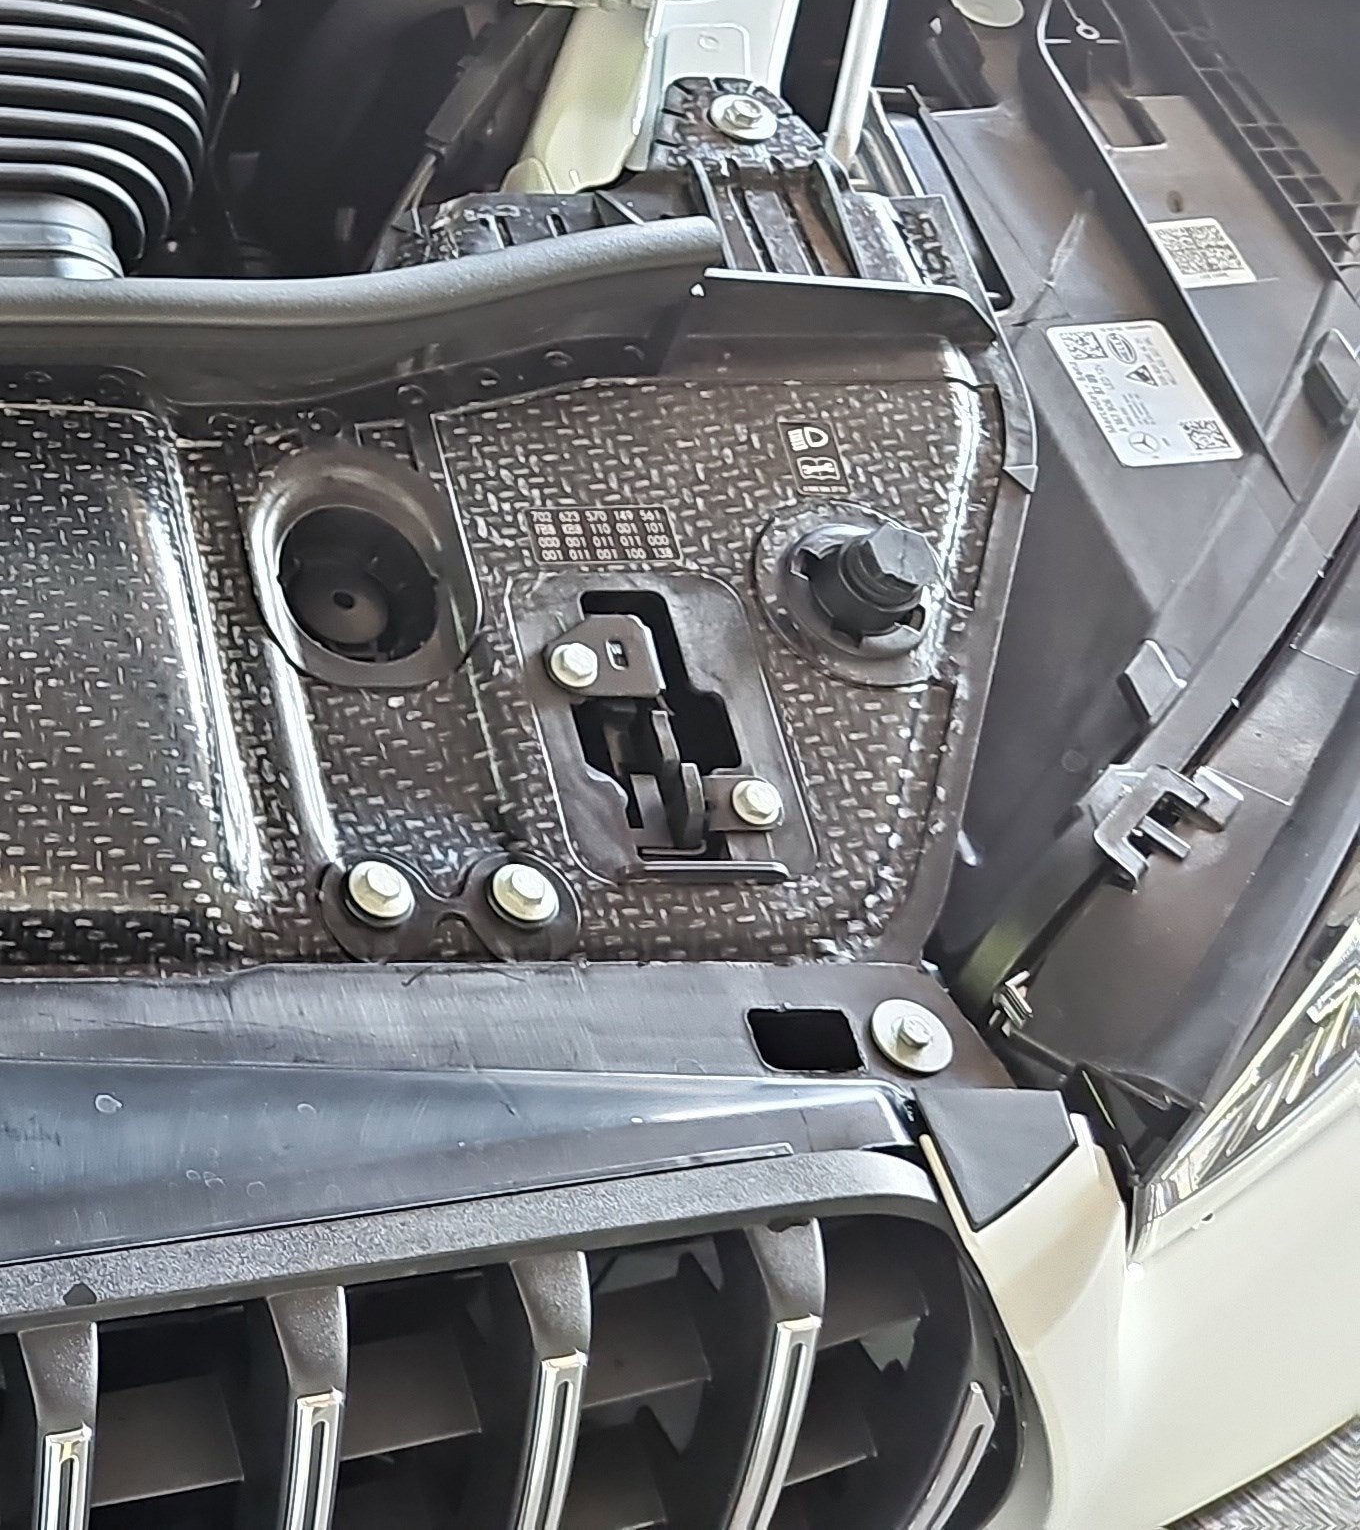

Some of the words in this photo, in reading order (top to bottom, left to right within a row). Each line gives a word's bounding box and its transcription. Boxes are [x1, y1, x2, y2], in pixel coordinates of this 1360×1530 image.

[590, 523, 611, 535] 110
[616, 523, 638, 534] 001
[644, 522, 665, 533] 101
[538, 536, 560, 548] 000
[565, 536, 587, 548] 001
[592, 536, 614, 547] 011
[620, 535, 641, 546] 011
[647, 535, 669, 546] 000
[542, 549, 563, 560] 001
[569, 549, 591, 560] 011
[596, 549, 618, 560] 001
[625, 548, 646, 559] 100
